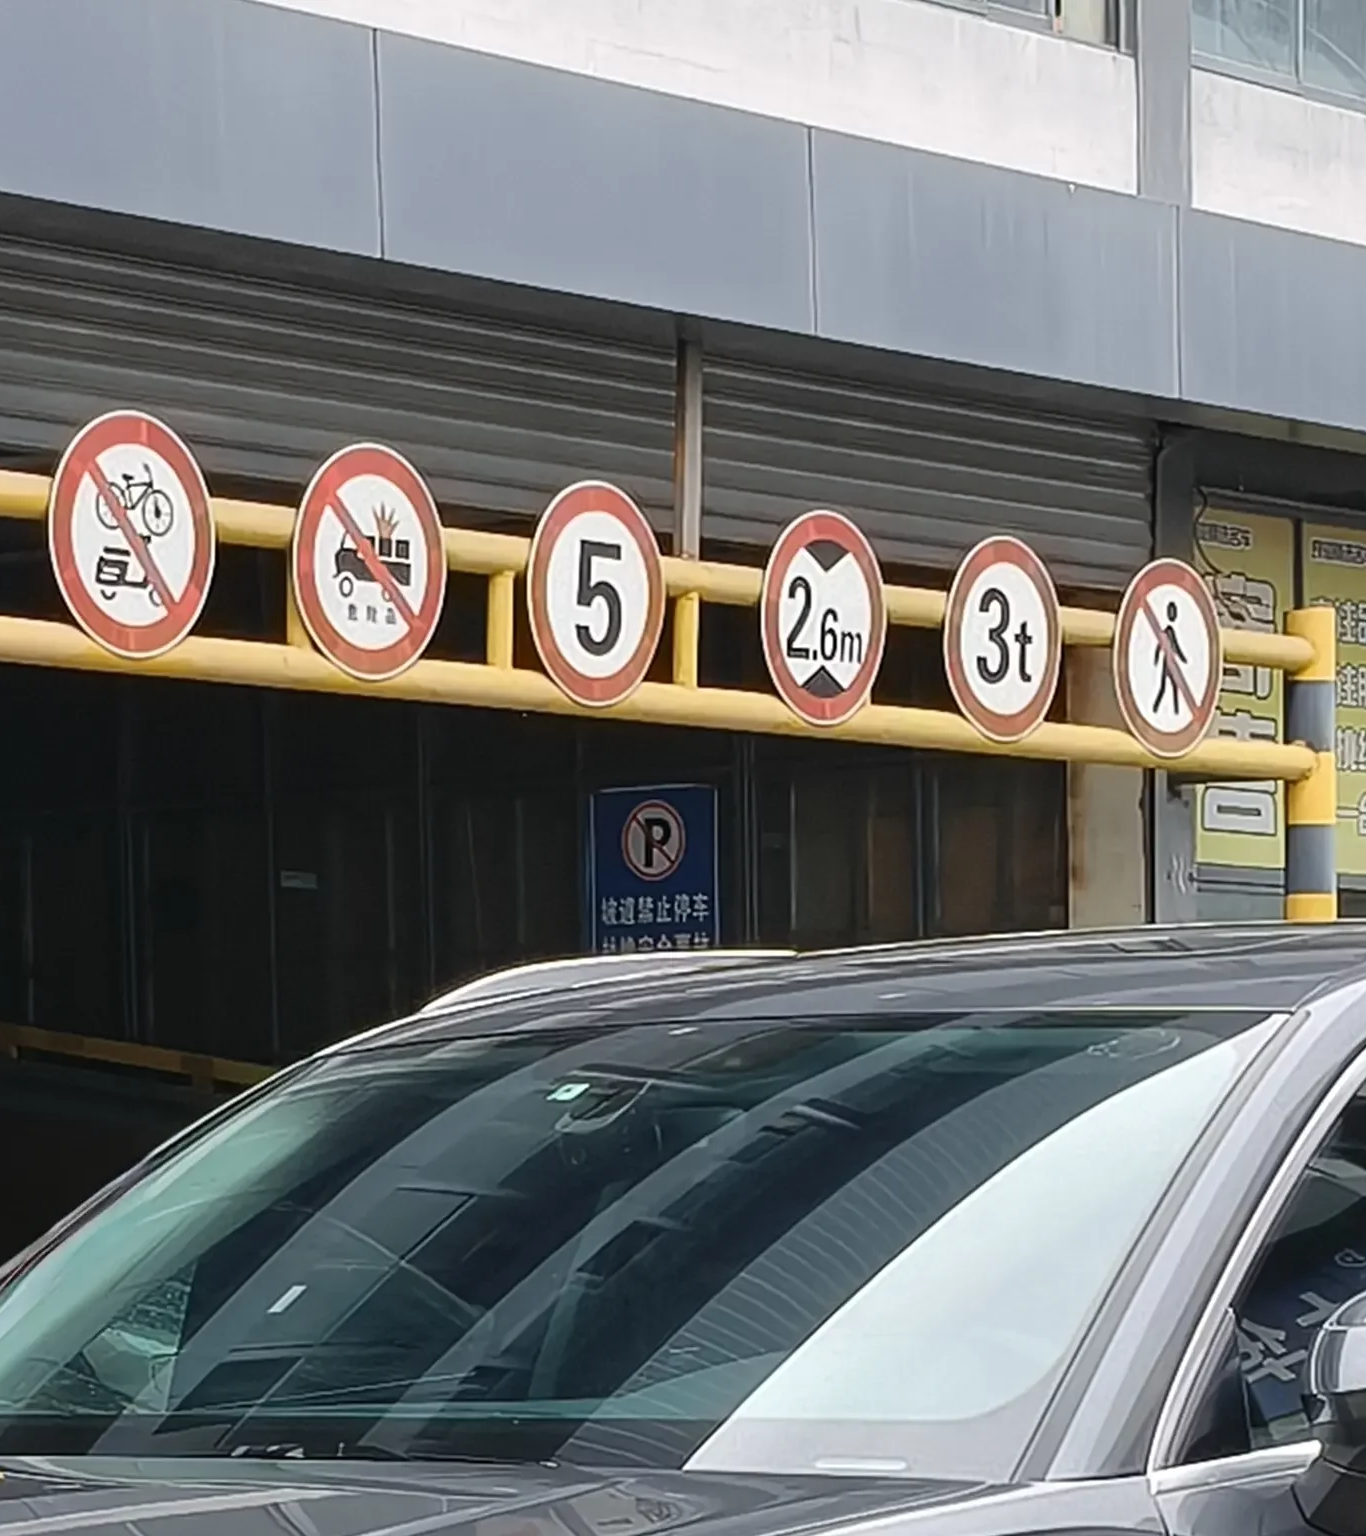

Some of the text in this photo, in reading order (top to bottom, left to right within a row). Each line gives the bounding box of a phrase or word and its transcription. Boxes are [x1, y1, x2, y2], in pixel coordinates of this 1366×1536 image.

[575, 538, 623, 656] 5
[785, 575, 864, 665] 2.6m
[976, 587, 1033, 684] 3t
